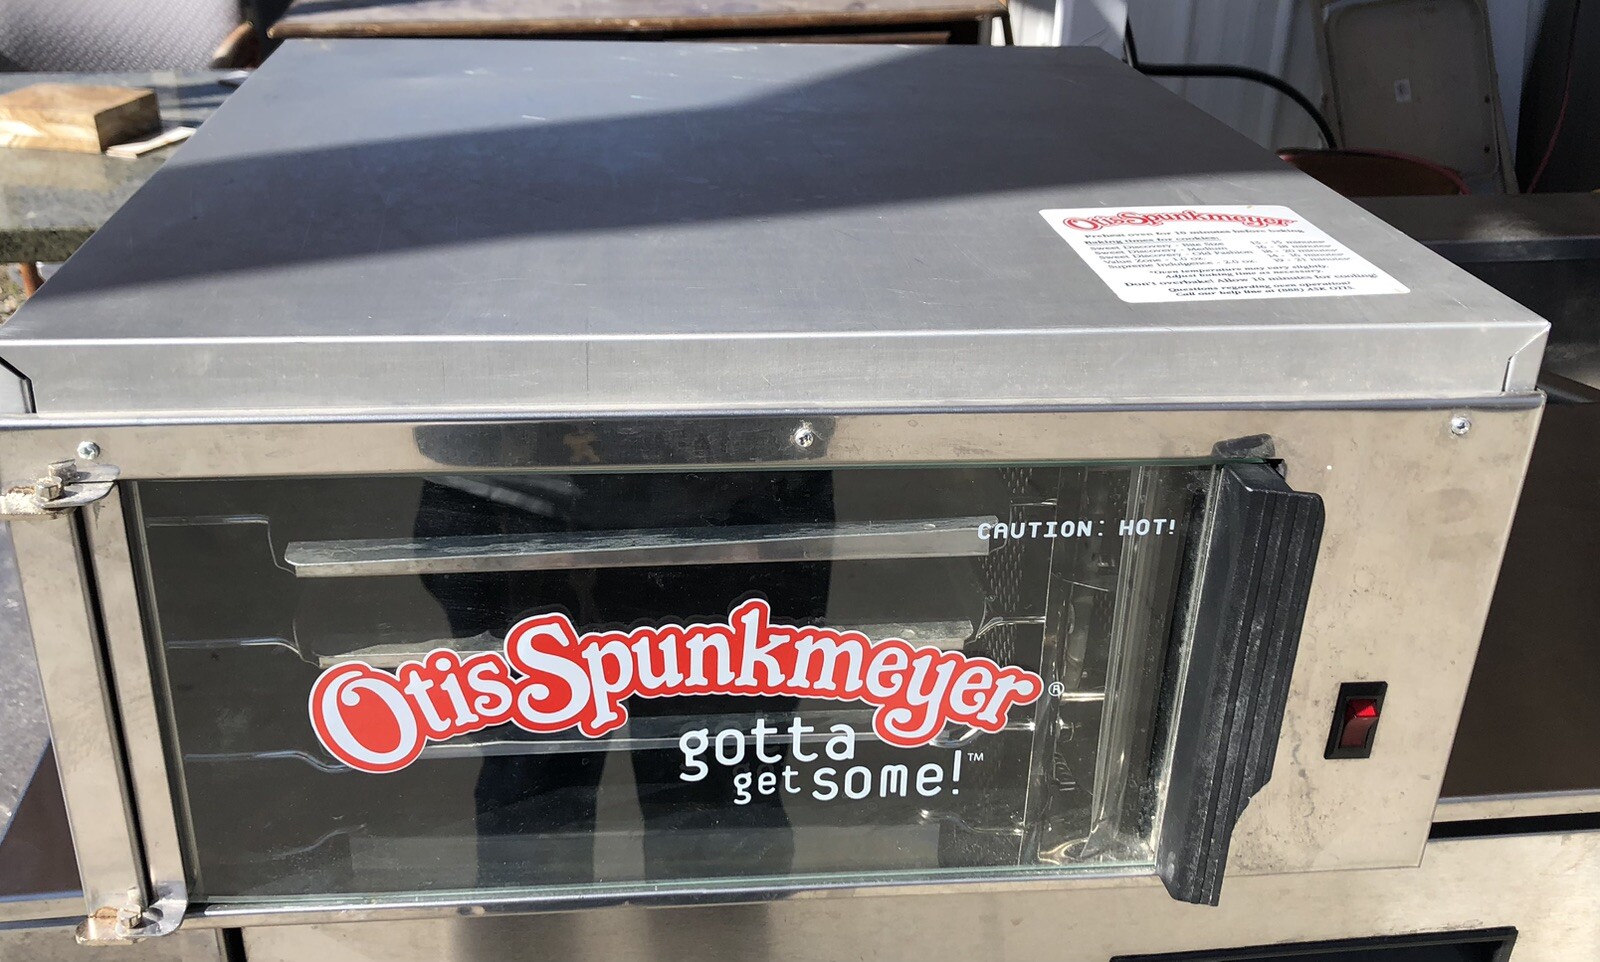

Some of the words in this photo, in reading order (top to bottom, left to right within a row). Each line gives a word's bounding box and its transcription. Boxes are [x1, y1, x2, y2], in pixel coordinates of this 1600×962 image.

[1063, 215, 1122, 231] Otis
[1117, 210, 1297, 228] Spunkmeyer
[977, 520, 1105, 540] CAUTION:
[1118, 518, 1176, 536] HOT!
[316, 652, 515, 769] Otis
[511, 603, 1038, 745] Spunkmeyer
[678, 716, 856, 782] gotta
[733, 765, 801, 805] get
[811, 749, 962, 801] some!
